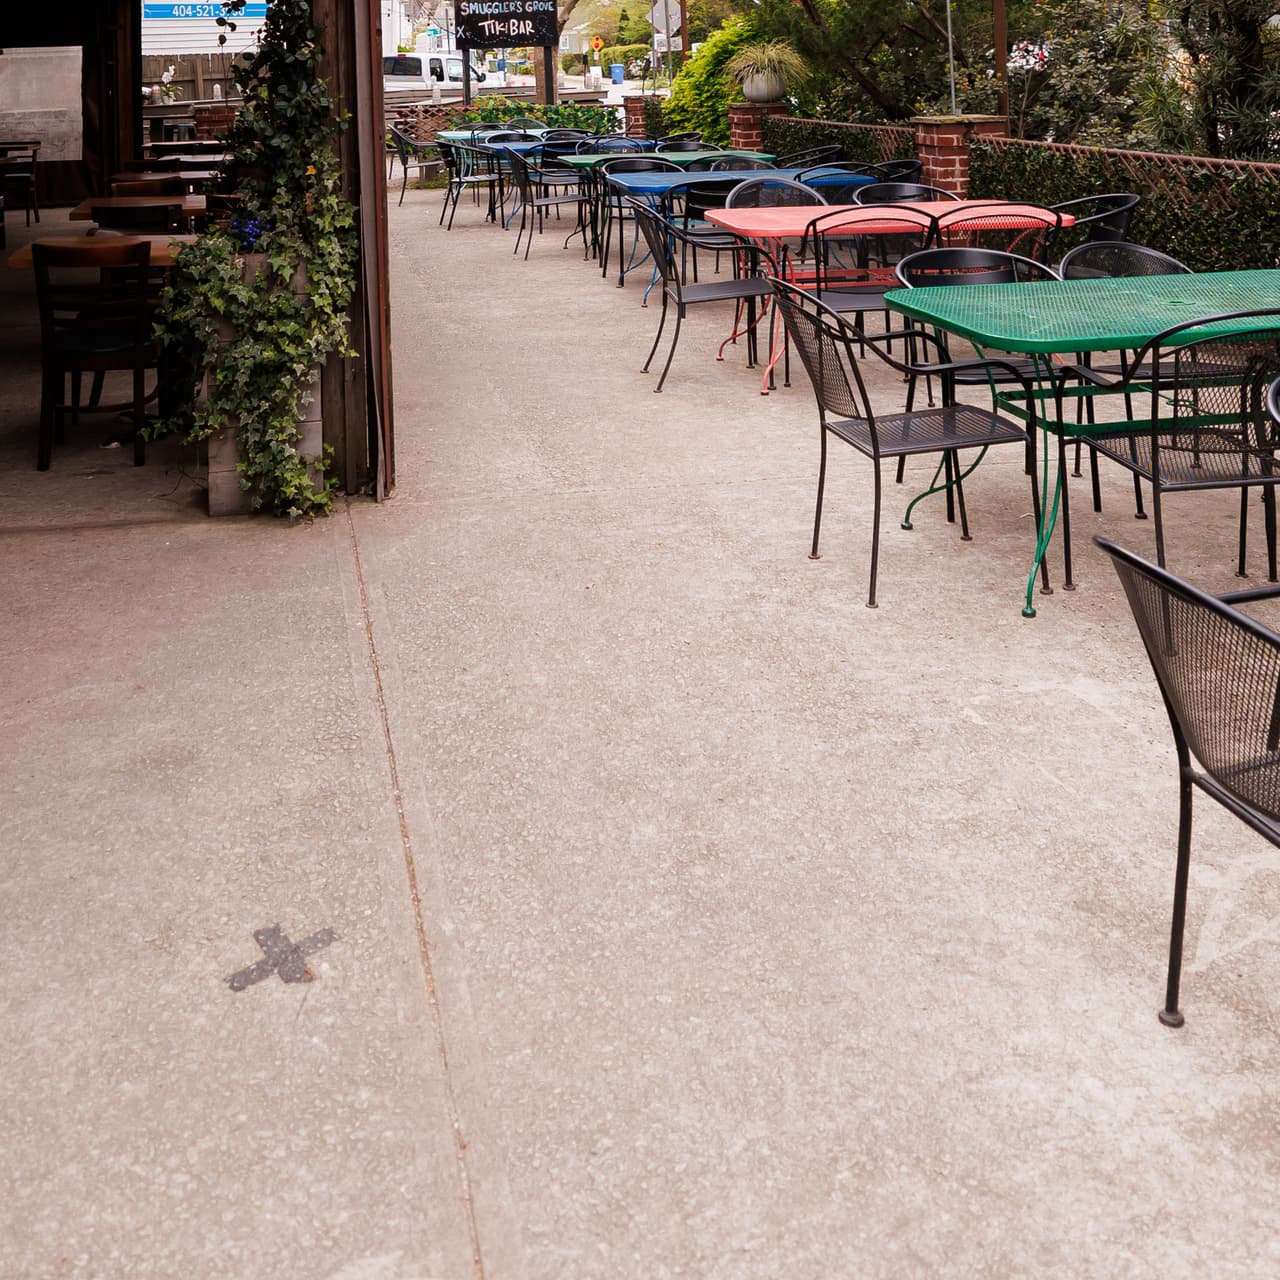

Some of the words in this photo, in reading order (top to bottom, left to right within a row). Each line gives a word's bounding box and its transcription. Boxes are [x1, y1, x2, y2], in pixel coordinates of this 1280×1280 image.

[460, 1, 523, 16] SMUGGLER'S
[525, 0, 555, 12] GROVE
[509, 18, 535, 36] BAR
